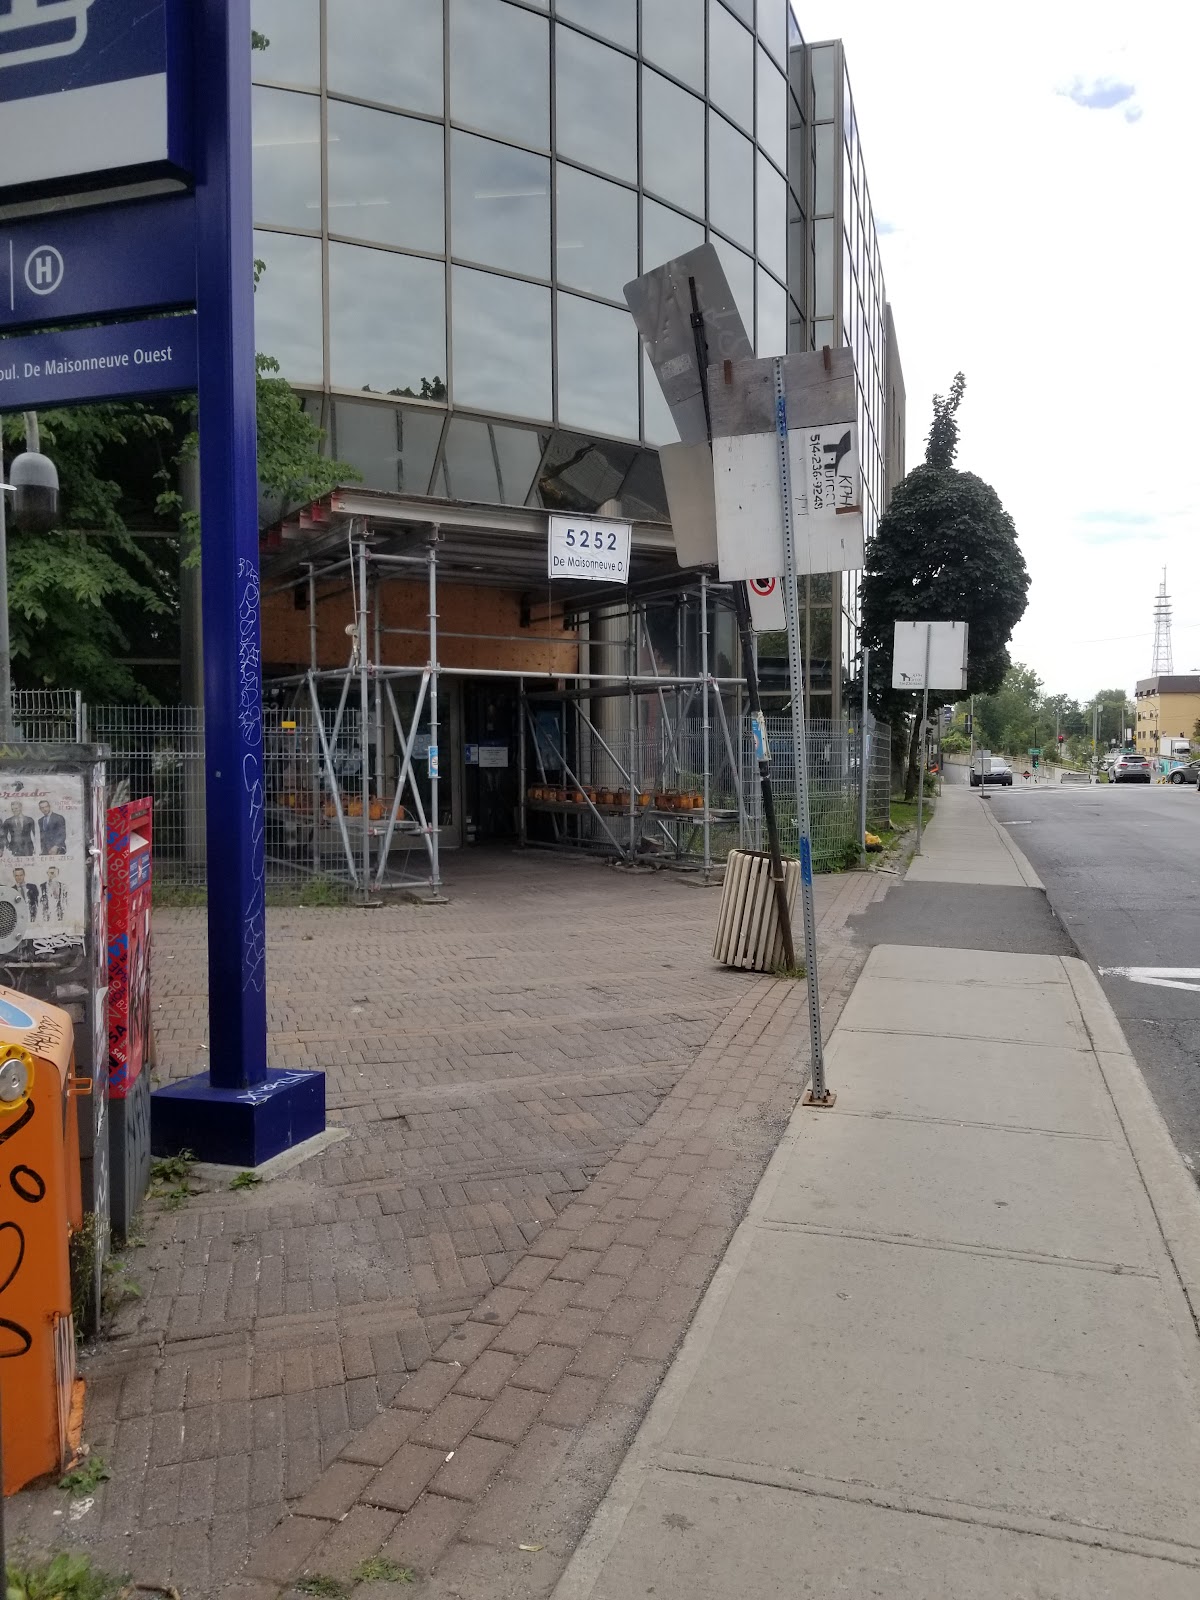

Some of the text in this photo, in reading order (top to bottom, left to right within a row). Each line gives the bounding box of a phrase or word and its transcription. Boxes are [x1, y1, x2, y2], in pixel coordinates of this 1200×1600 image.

[24, 363, 41, 378] De
[45, 354, 129, 376] Maisonneuve
[133, 346, 172, 364] Ouest
[838, 474, 853, 507] KPH
[565, 529, 617, 551] 5252
[553, 556, 565, 567] De
[567, 557, 616, 571] Maisonneuve
